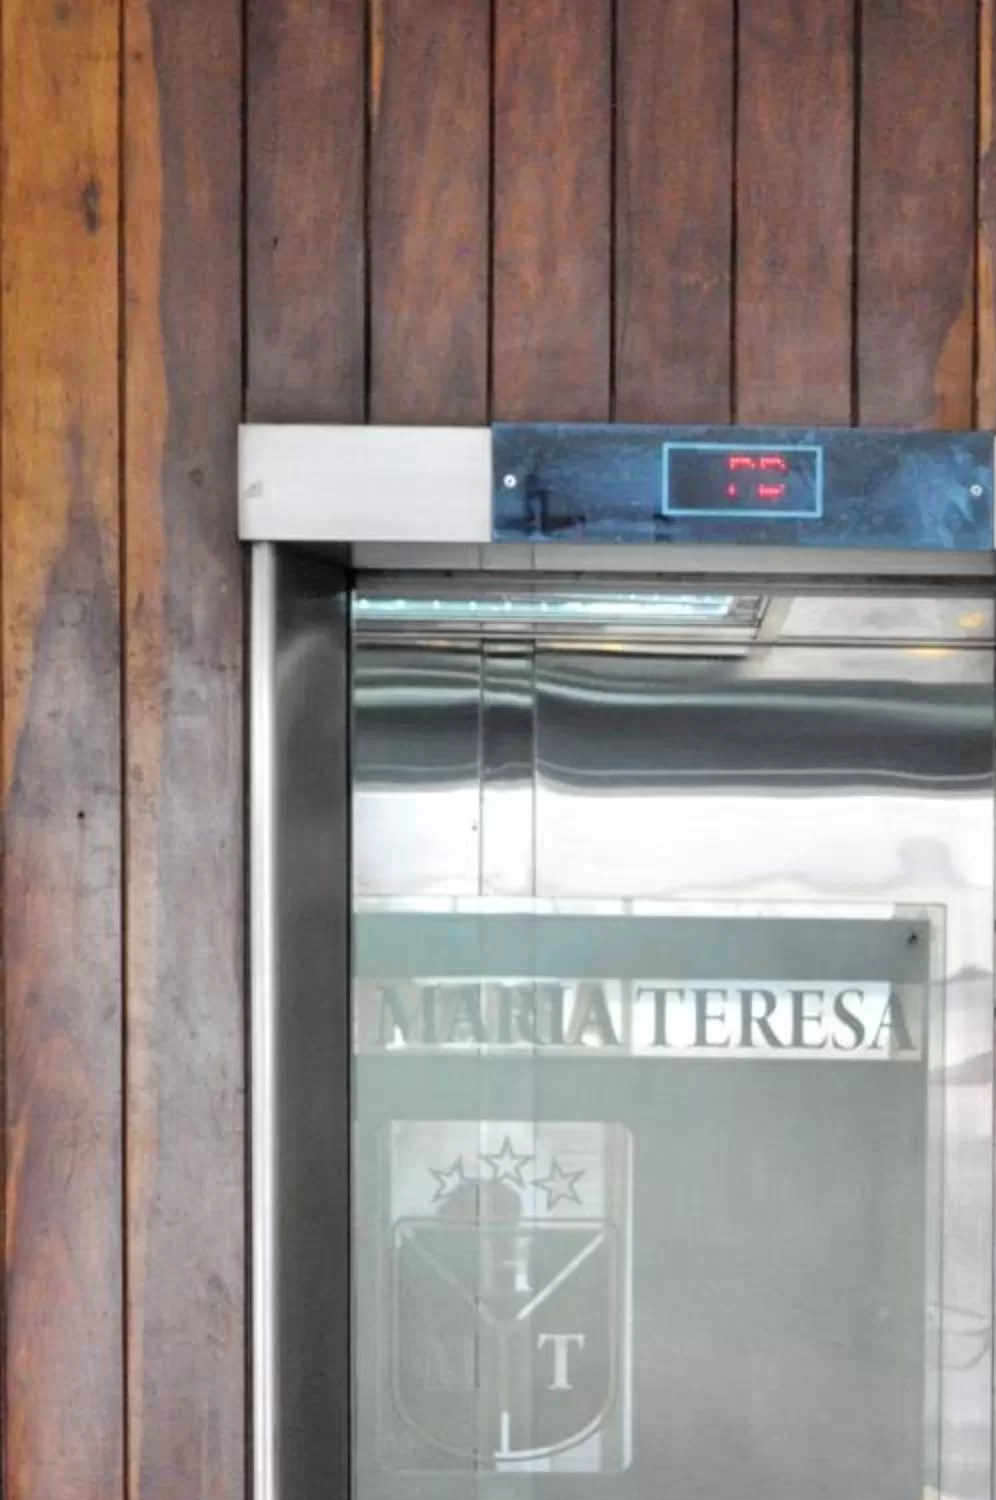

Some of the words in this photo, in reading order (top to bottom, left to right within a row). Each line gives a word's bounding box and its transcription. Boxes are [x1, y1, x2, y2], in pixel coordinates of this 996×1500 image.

[374, 981, 622, 1047] MARIA
[634, 986, 917, 1051] TERESA
[536, 1331, 588, 1392] T
